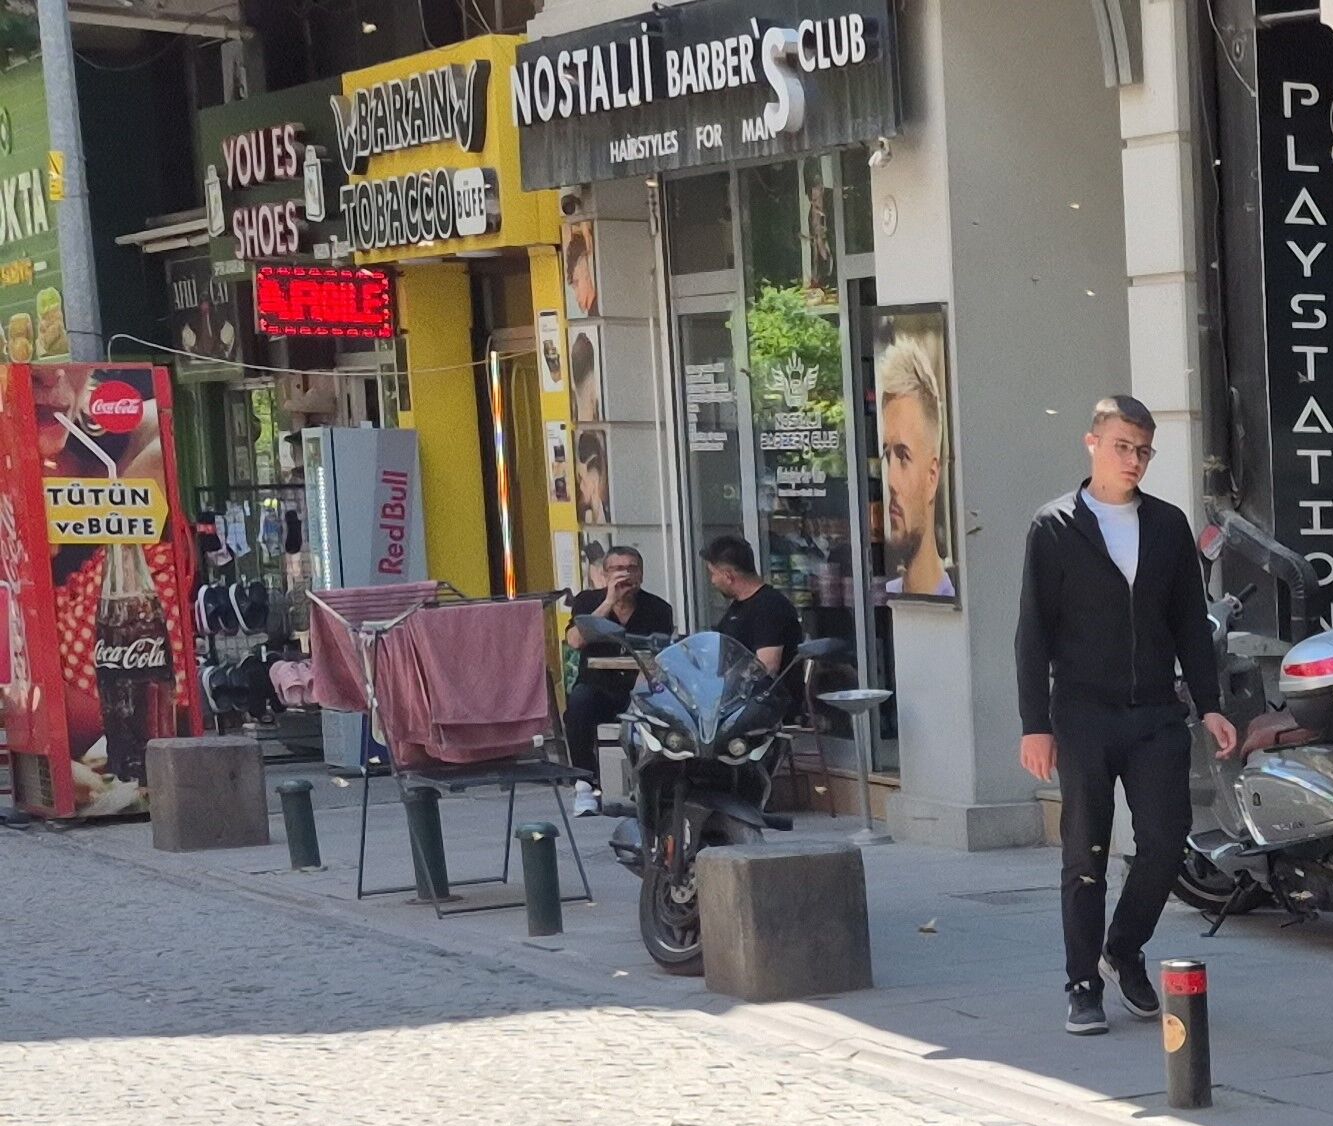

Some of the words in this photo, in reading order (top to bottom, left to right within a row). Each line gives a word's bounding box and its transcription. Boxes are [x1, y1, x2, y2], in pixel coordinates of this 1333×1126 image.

[798, 13, 866, 73] CLUB
[354, 66, 452, 157] BARAN
[696, 124, 723, 150] FOR
[222, 128, 266, 191] YOU
[272, 124, 298, 177] ES
[232, 200, 300, 260] SHOES
[340, 167, 452, 252] TOBACCO
[455, 185, 486, 221] BÜFE
[47, 483, 150, 506] TÜTÜN
[382, 470, 408, 519] Bull
[379, 524, 405, 574] Red
